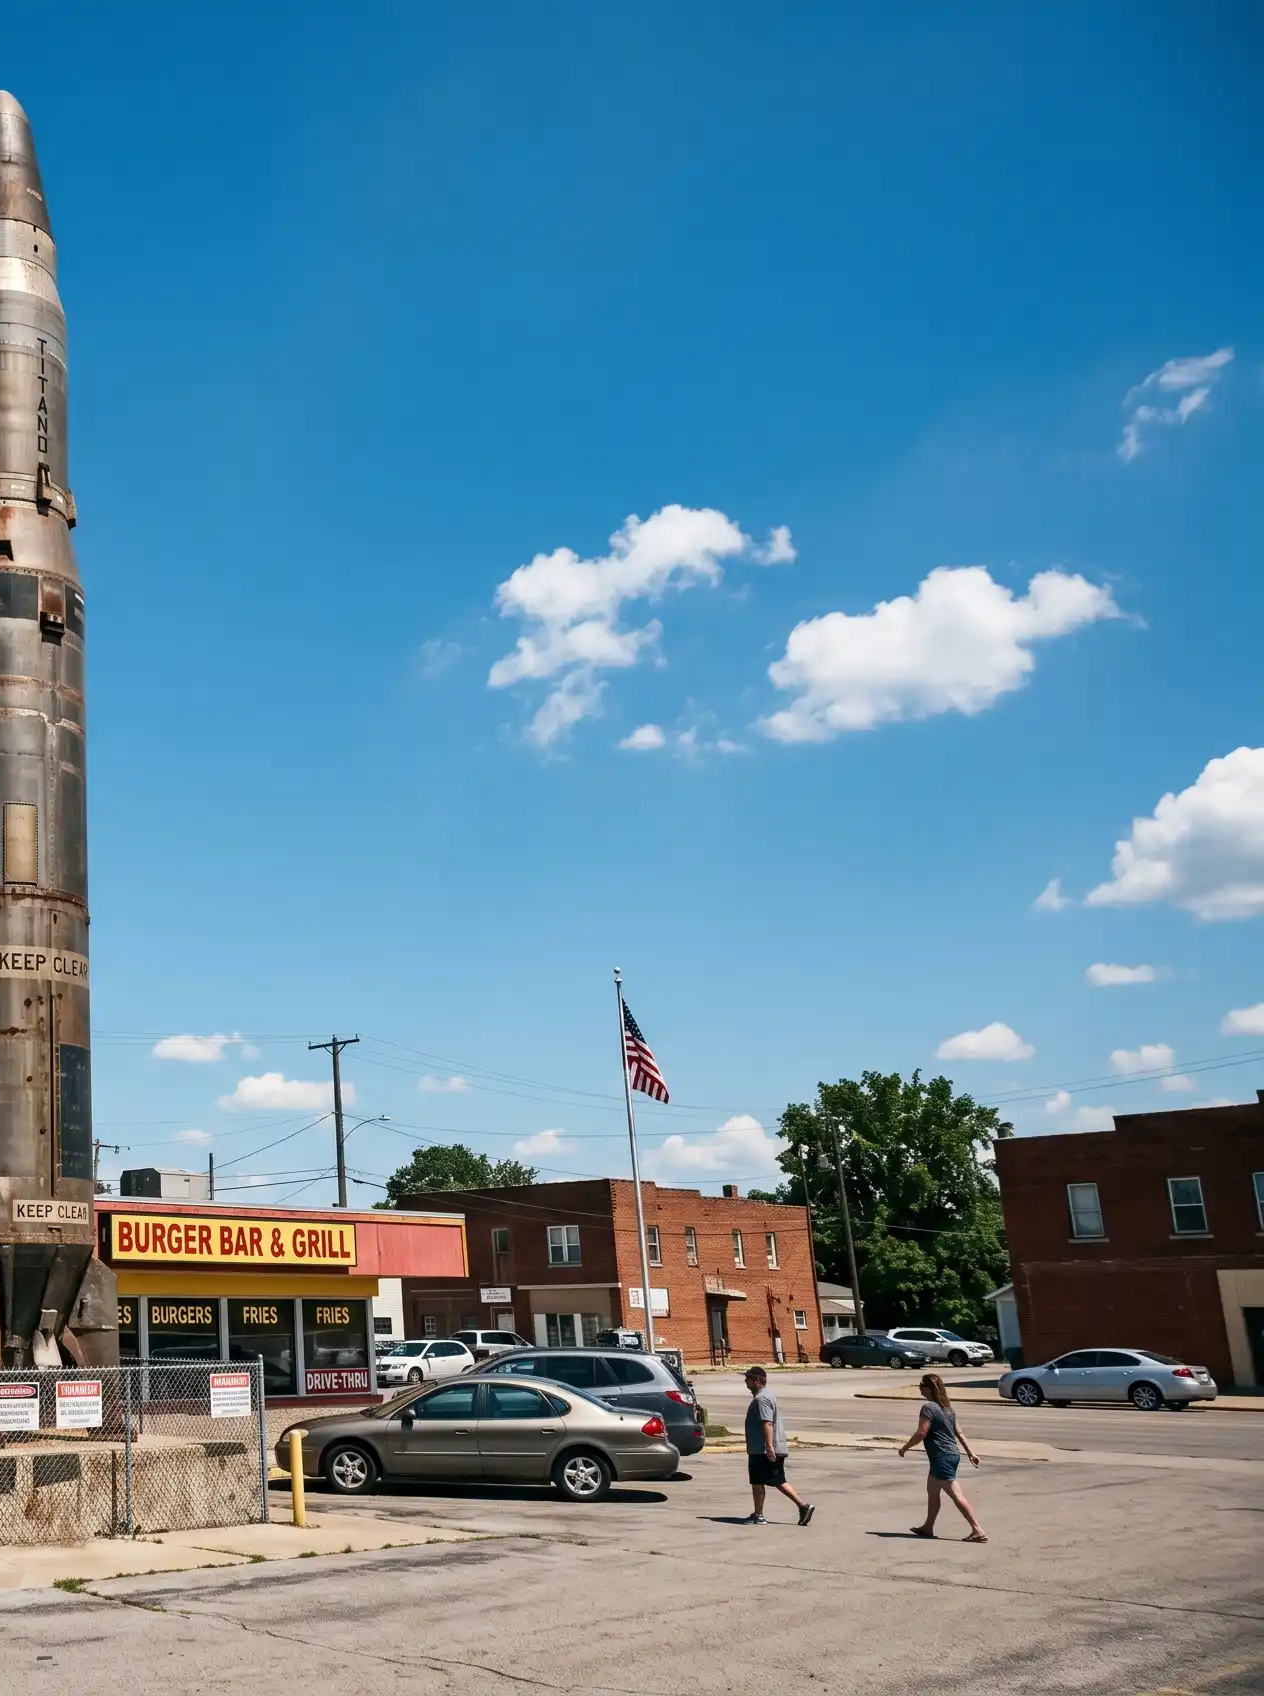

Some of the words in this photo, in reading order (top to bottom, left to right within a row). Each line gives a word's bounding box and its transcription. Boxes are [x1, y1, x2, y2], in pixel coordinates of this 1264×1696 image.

[17, 1203, 53, 1218] KEEP
[118, 1221, 213, 1256] BURGER
[219, 1225, 264, 1257] BAR
[270, 1227, 286, 1258] &
[292, 1228, 351, 1259] GRILL
[151, 1305, 213, 1325] BURGERS
[243, 1305, 278, 1325] FRIES
[316, 1306, 350, 1325] FRIES
[306, 1371, 368, 1390] DRIVE-THRU
